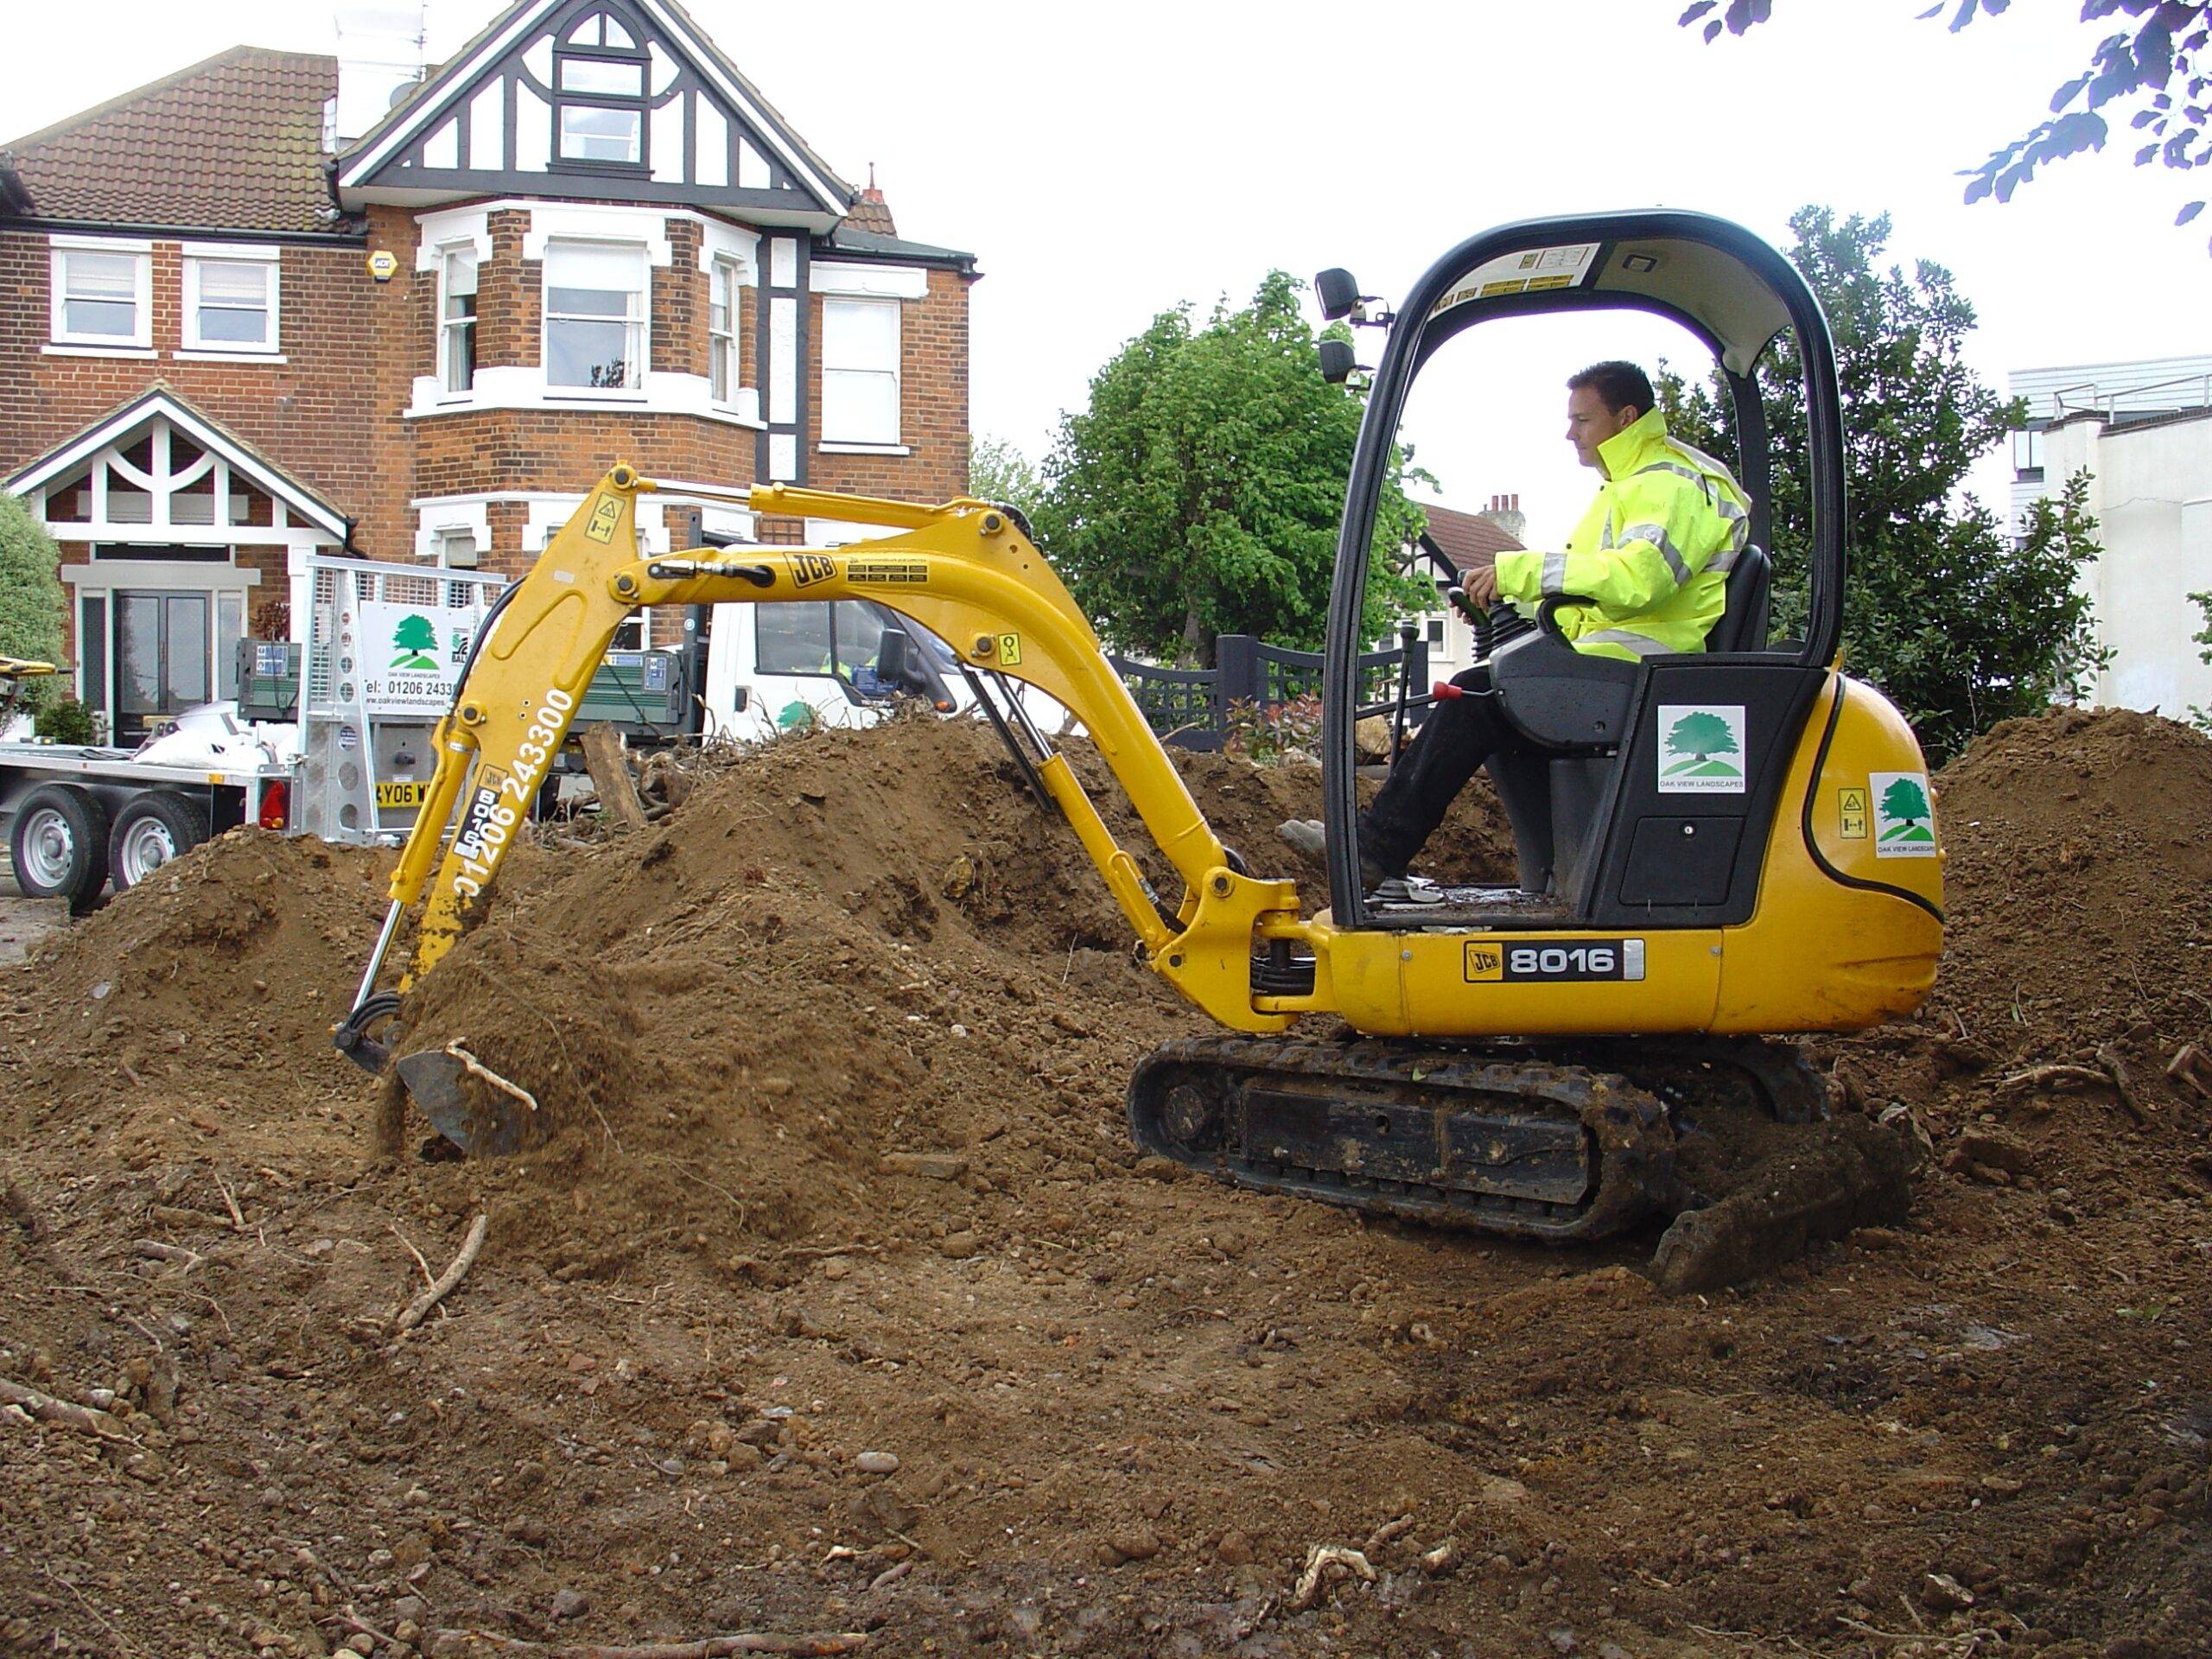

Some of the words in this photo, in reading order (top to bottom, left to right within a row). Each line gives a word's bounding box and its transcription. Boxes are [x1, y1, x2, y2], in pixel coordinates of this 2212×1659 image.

[793, 554, 834, 584] JCB
[365, 679, 381, 694] el:
[388, 680, 423, 695] 01206
[453, 804, 516, 898] 01206
[501, 689, 573, 803] 243300
[1474, 952, 1499, 970] JCB
[1510, 948, 1615, 974] 8016
